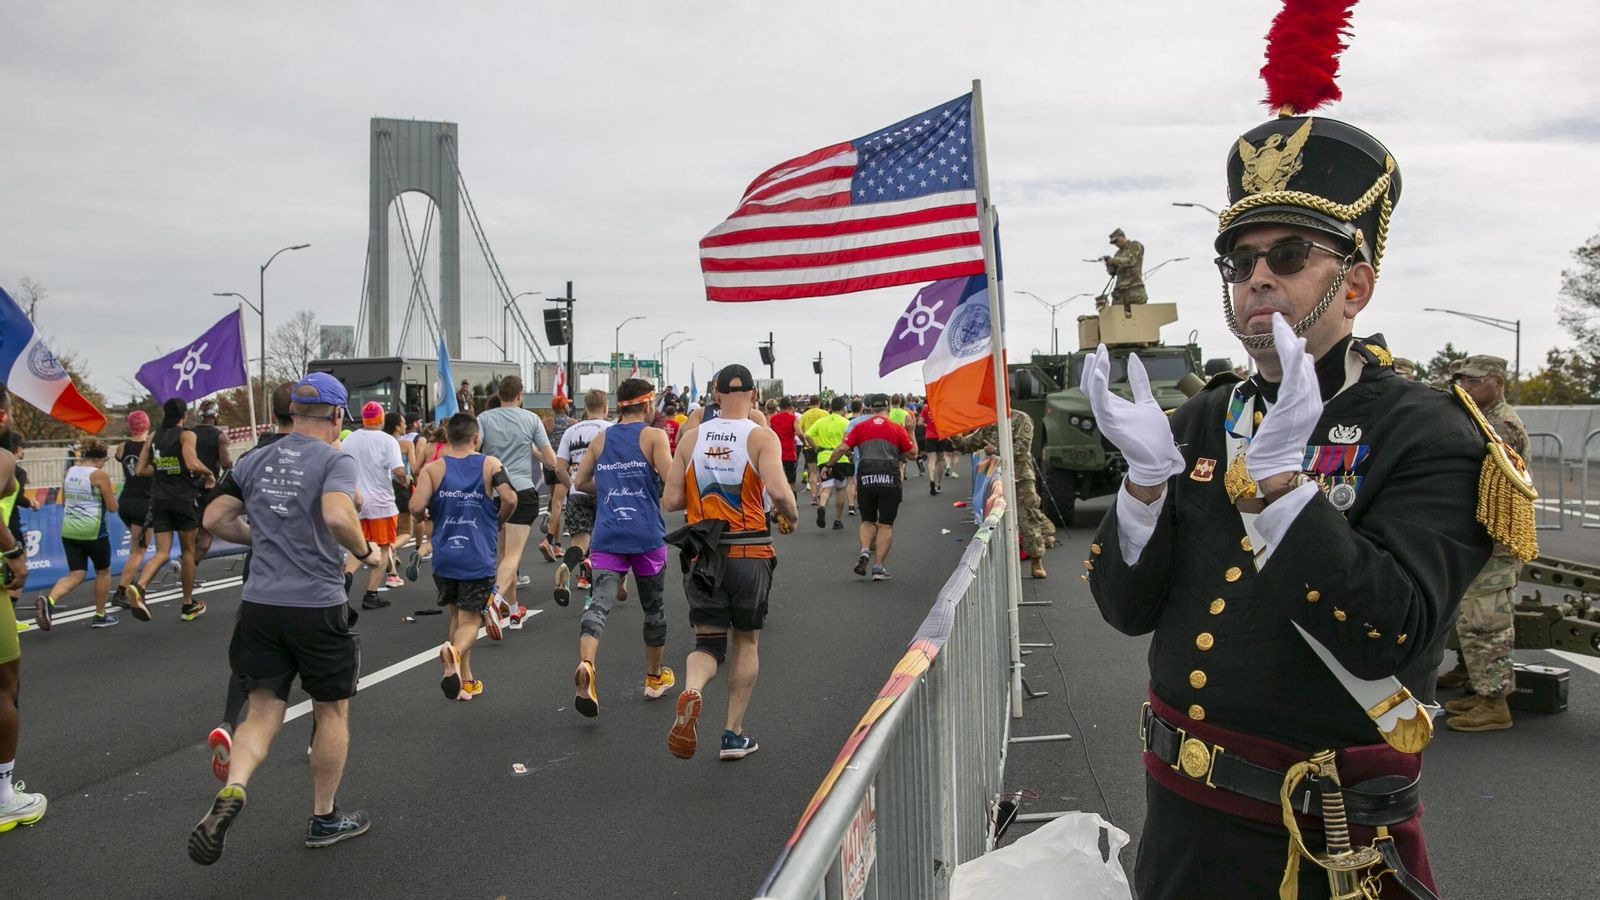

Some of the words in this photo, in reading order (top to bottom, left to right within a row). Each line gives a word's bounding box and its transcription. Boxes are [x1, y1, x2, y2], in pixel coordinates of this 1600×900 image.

[705, 431, 737, 443] Finish
[597, 460, 646, 471] DetecTogether
[861, 474, 890, 485] OTTAWA
[25, 559, 51, 570] alance
